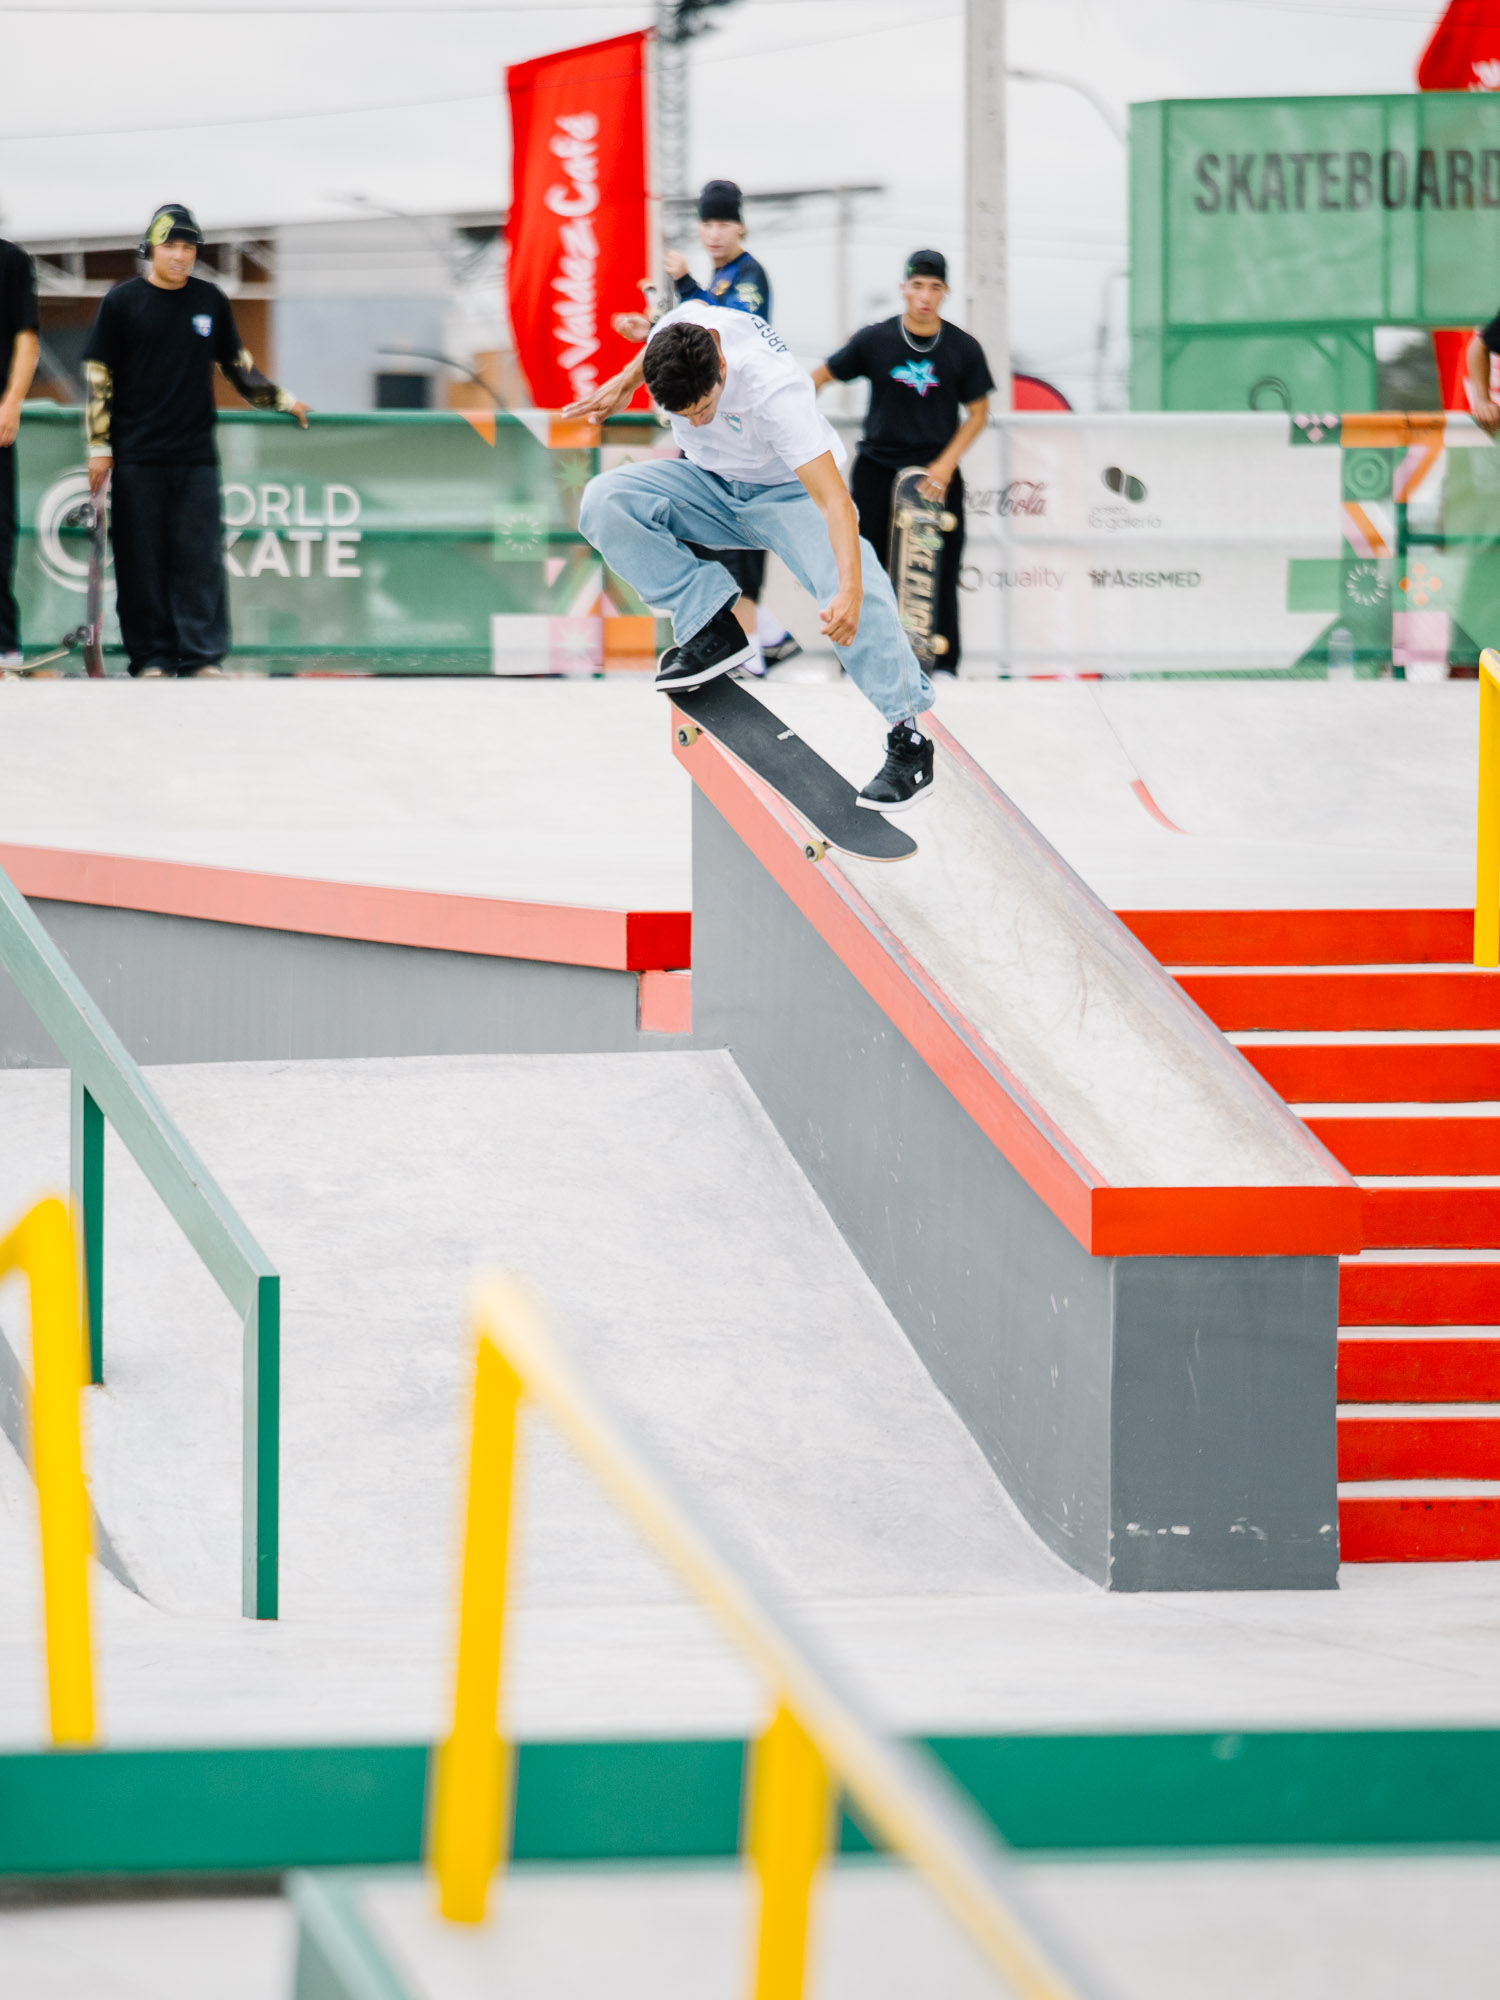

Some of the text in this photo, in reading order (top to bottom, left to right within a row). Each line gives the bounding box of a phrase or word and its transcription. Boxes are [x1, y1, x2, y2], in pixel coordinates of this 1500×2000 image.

[551, 217, 601, 370] Valdez
[751, 316, 789, 352] ARGE
[221, 483, 361, 527] ORLD
[223, 530, 361, 578] KATE
[989, 567, 1064, 591] quality
